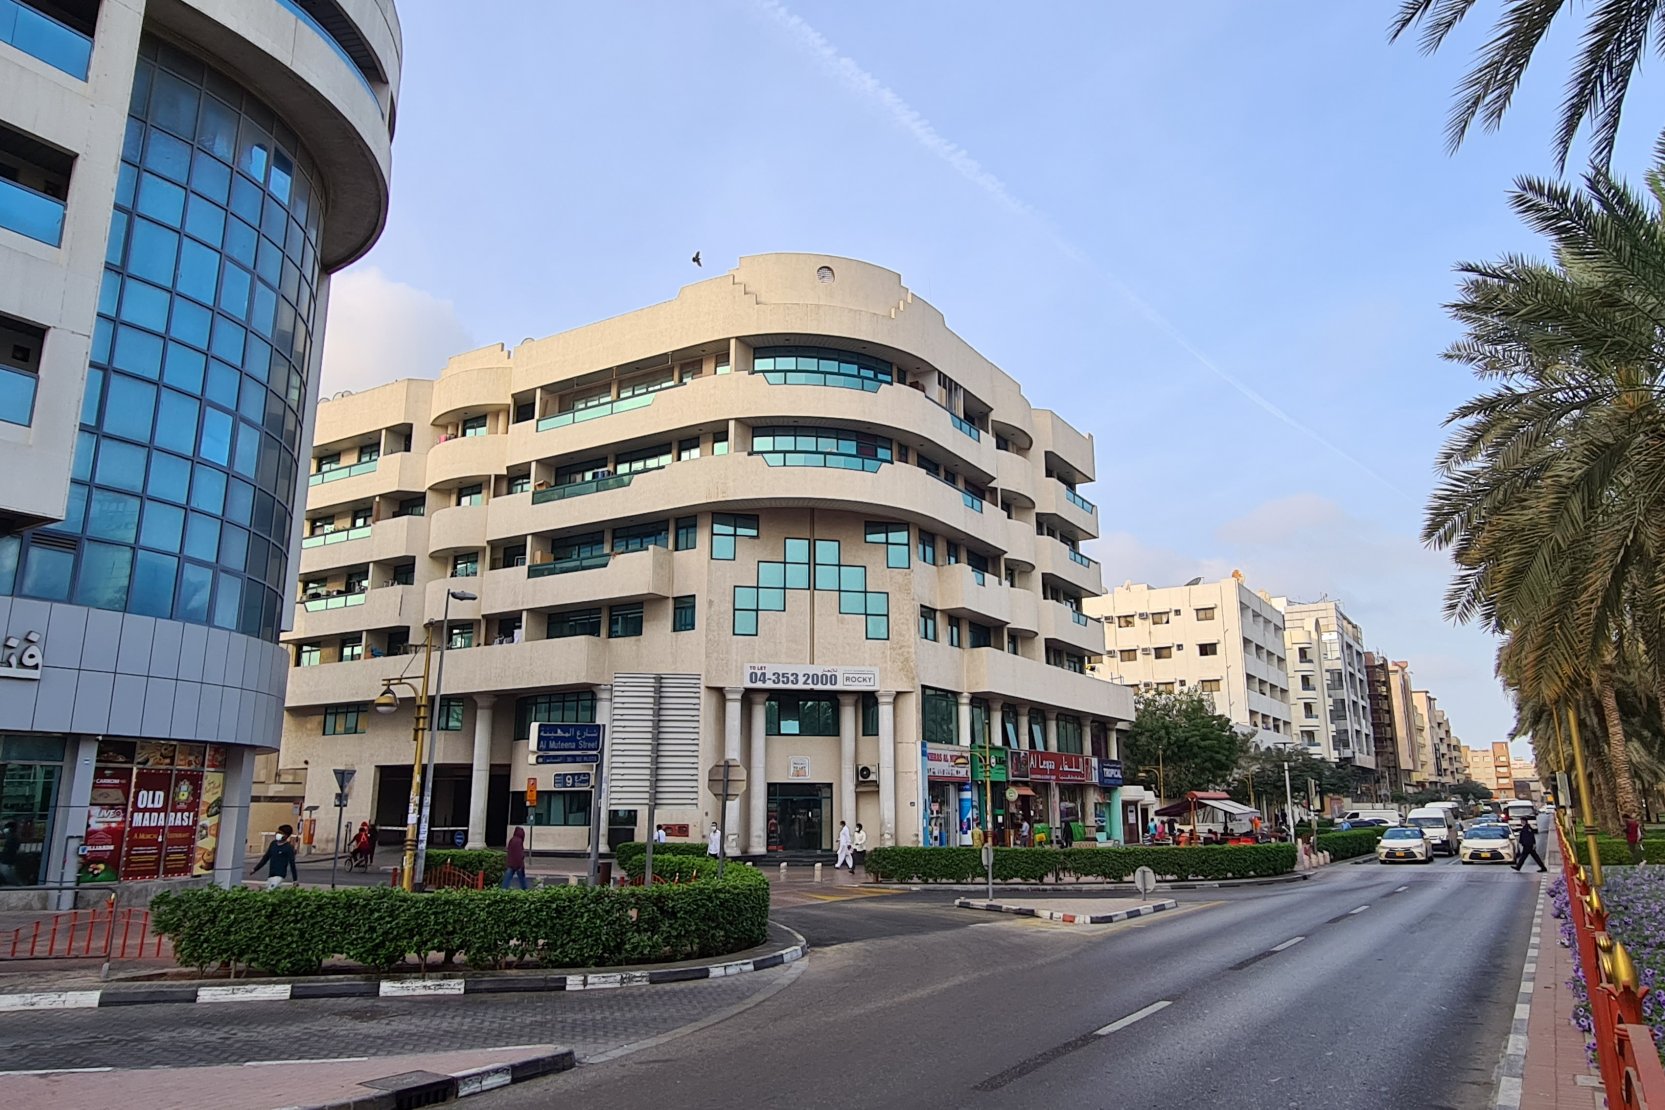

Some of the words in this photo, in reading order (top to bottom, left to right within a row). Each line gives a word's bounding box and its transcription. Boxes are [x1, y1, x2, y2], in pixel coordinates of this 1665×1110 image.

[749, 671, 799, 685] 04-353
[802, 673, 838, 686] 2000
[576, 727, 598, 740] شارع
[539, 740, 547, 749] Al
[549, 740, 576, 749] Muteena
[578, 740, 598, 749] Street
[1029, 753, 1037, 768] Al
[565, 775, 573, 787] 9
[137, 790, 165, 809] OLD
